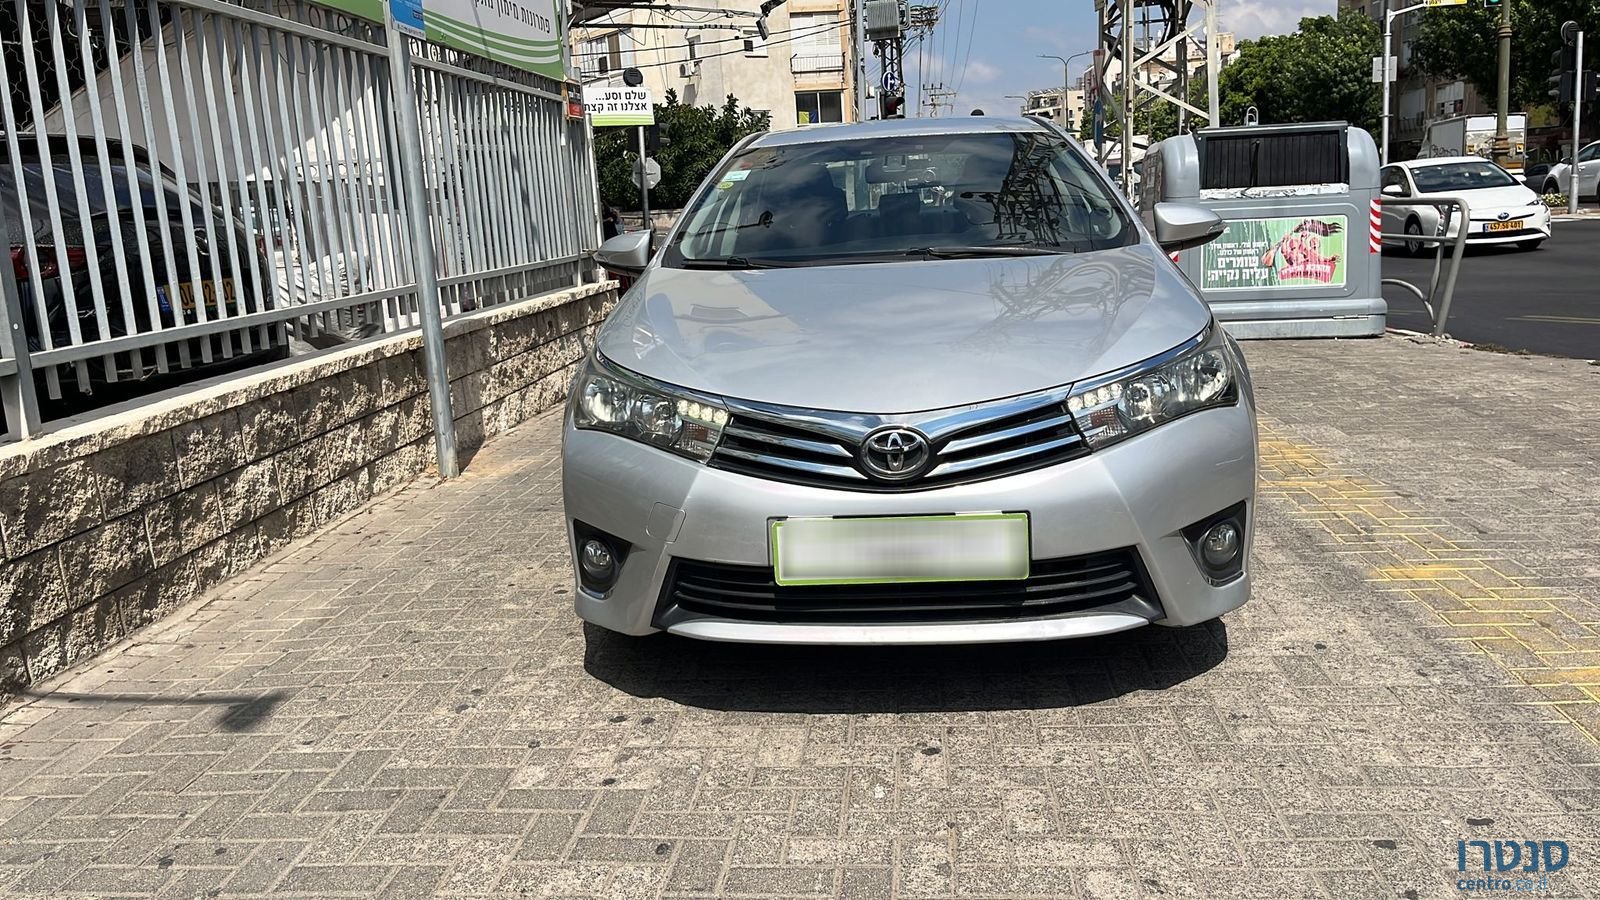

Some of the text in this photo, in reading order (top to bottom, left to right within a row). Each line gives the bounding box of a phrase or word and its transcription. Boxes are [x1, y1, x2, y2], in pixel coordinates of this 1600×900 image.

[496, 0, 551, 34] פתרונות מימון
[595, 90, 647, 101] שלם וסע...
[583, 101, 648, 114] אצלנו זה קצת
[1233, 248, 1242, 256] של
[1217, 256, 1259, 269] שומרים
[1207, 269, 1240, 282] נקייה!
[1241, 267, 1269, 280] עליה
